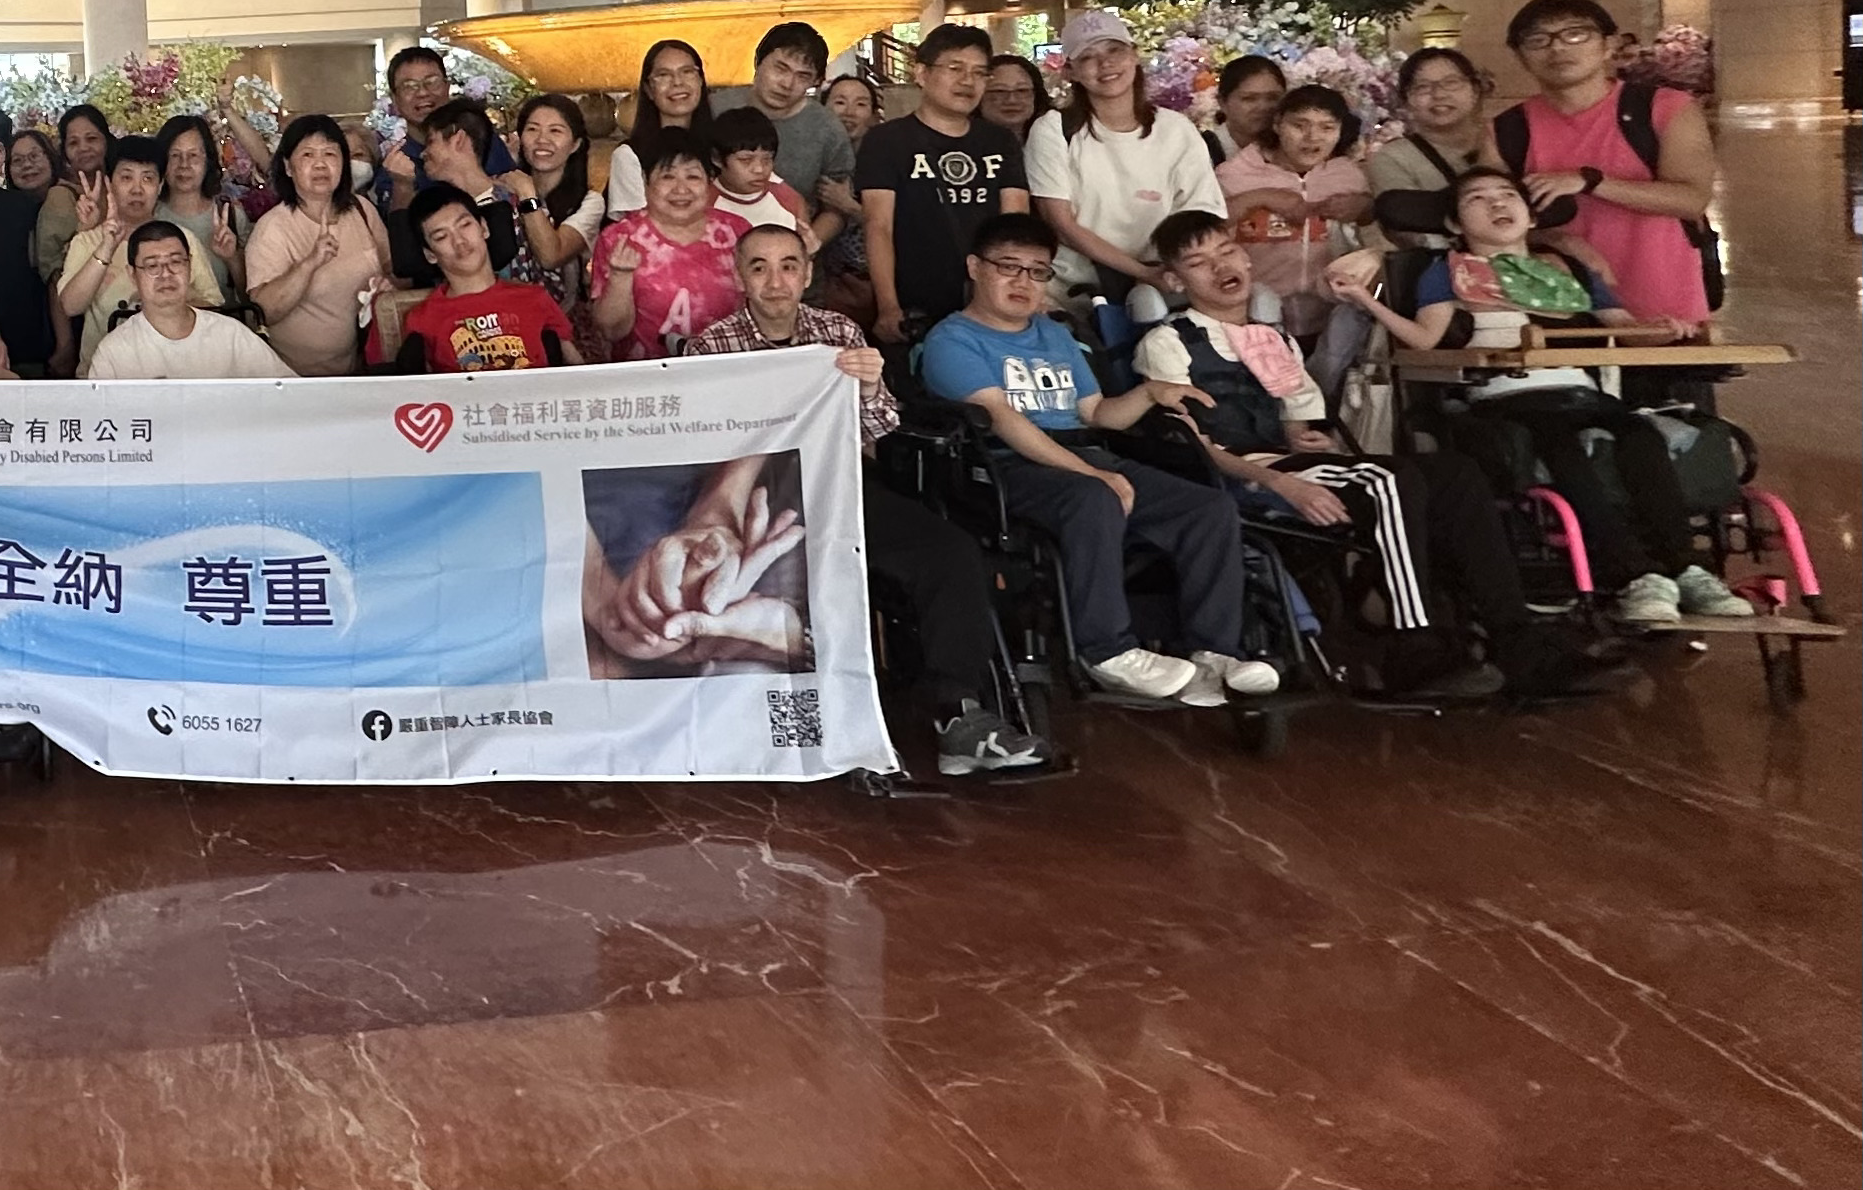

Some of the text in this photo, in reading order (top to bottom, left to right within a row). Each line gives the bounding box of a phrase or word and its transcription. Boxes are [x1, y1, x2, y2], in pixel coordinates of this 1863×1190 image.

[910, 153, 1004, 179] A F
[462, 394, 682, 427] 社會福利署資助服務
[462, 430, 531, 444] Subsidised
[534, 427, 581, 441] Service
[584, 427, 599, 442] by
[604, 426, 624, 438] the
[627, 422, 666, 436] Social
[669, 420, 723, 434] Welfare
[62, 449, 106, 463] Persons
[109, 449, 153, 463] Limited
[181, 554, 334, 627] 尊重
[182, 715, 262, 732] 6055 1627
